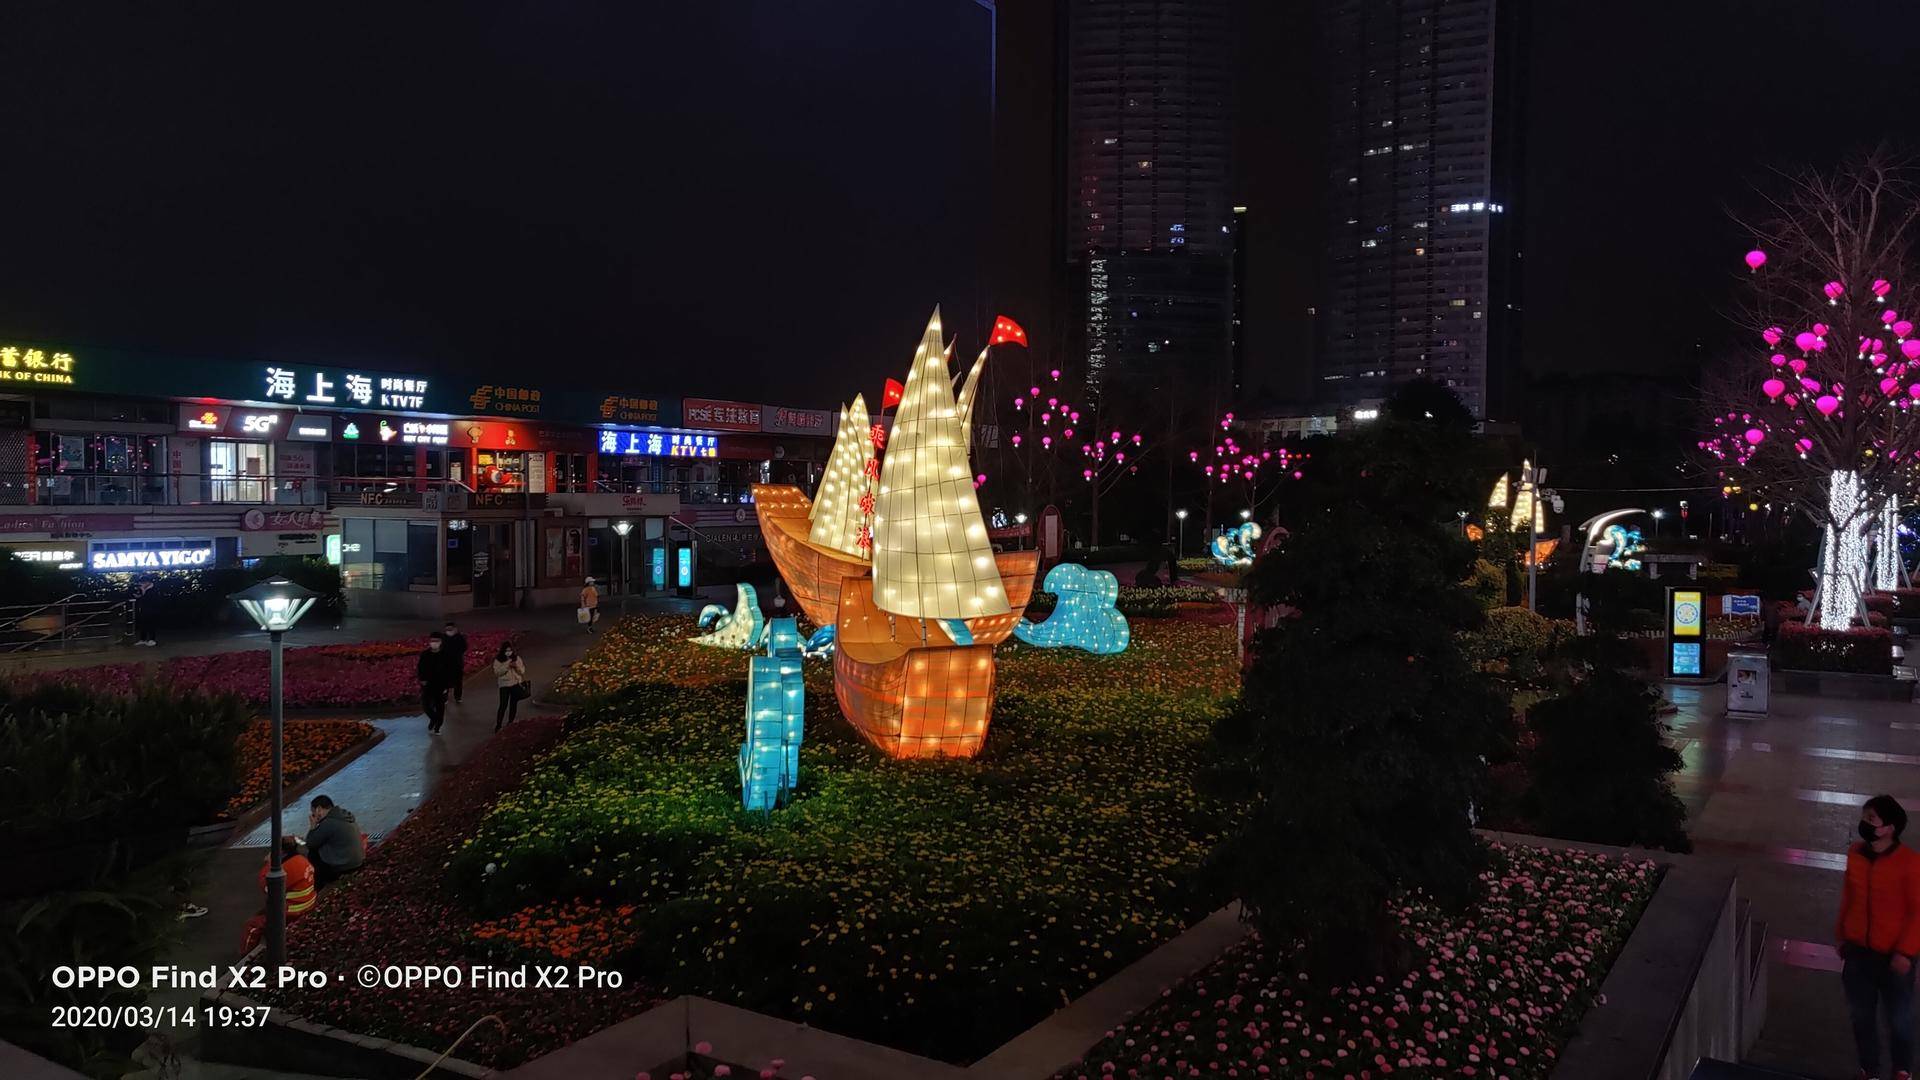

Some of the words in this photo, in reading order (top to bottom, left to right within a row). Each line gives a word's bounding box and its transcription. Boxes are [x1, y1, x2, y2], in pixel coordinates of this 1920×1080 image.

[15, 372, 31, 380] OF
[34, 373, 72, 384] CHINA
[266, 366, 372, 405] 海上海
[381, 378, 428, 394] 时尚餐厅
[601, 431, 663, 455] 海上海
[671, 446, 697, 456] KTV
[856, 424, 885, 551] 乘风破浪
[476, 495, 503, 506] NFC
[93, 552, 159, 569] SAMYA
[159, 550, 206, 567] YIGO
